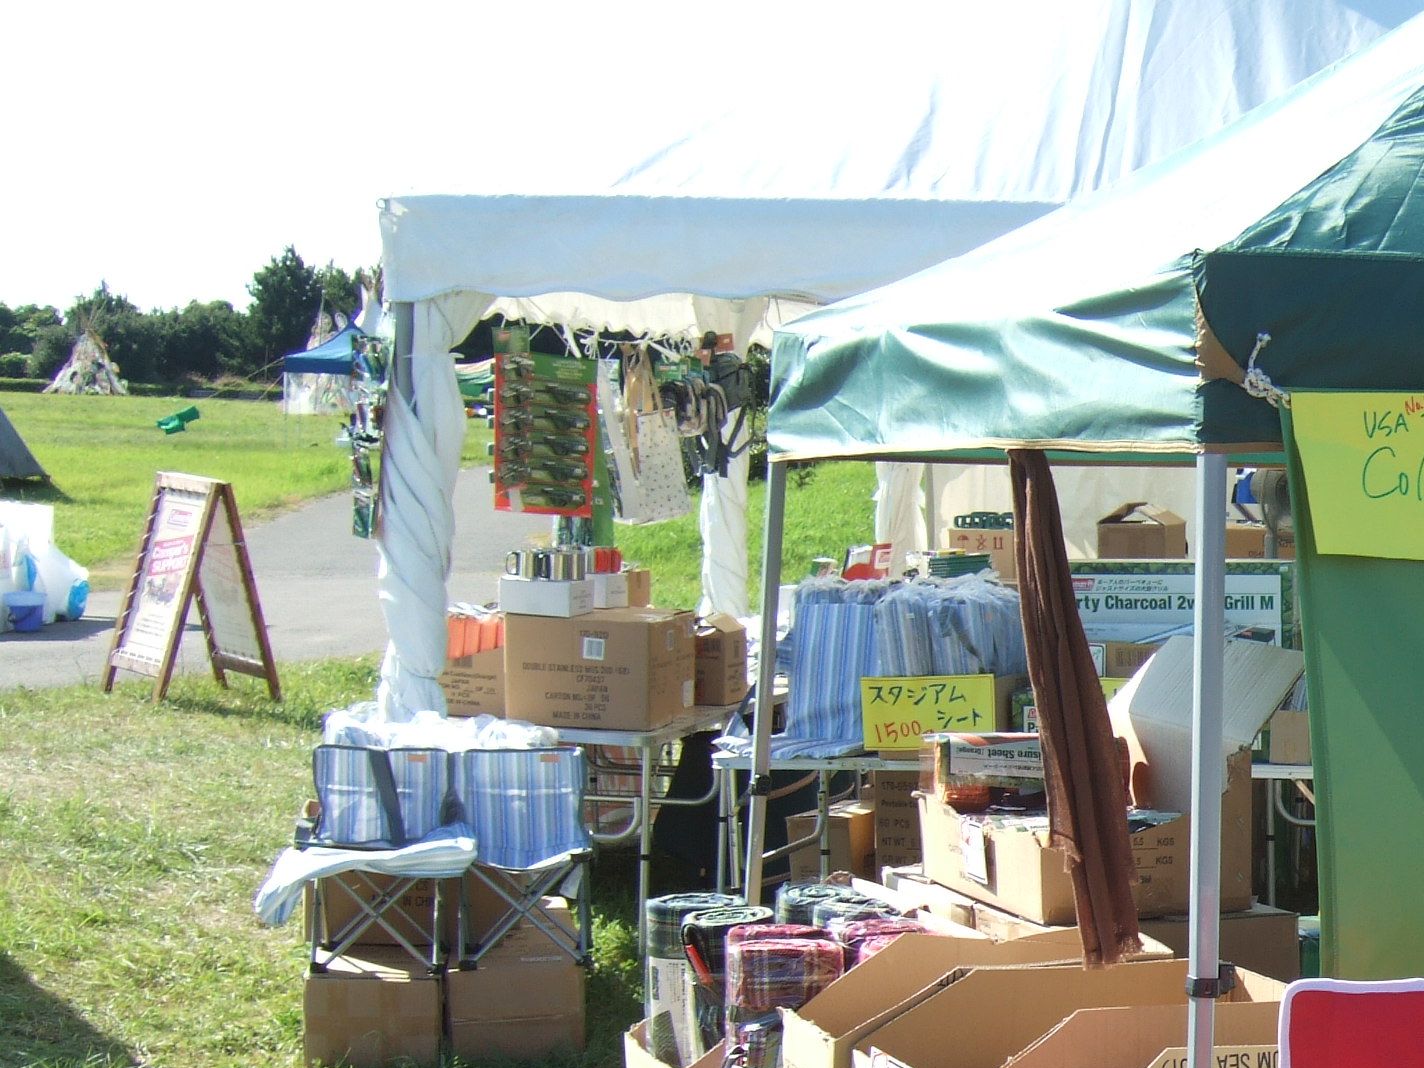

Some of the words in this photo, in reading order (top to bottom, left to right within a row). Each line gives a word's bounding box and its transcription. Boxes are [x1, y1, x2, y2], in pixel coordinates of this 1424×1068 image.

[1364, 411, 1409, 438] USA
[1104, 595, 1172, 611] Charcoal
[1224, 595, 1255, 611] Grill
[1260, 596, 1274, 611] M
[868, 683, 966, 706] スタジアム
[936, 708, 983, 730] シート
